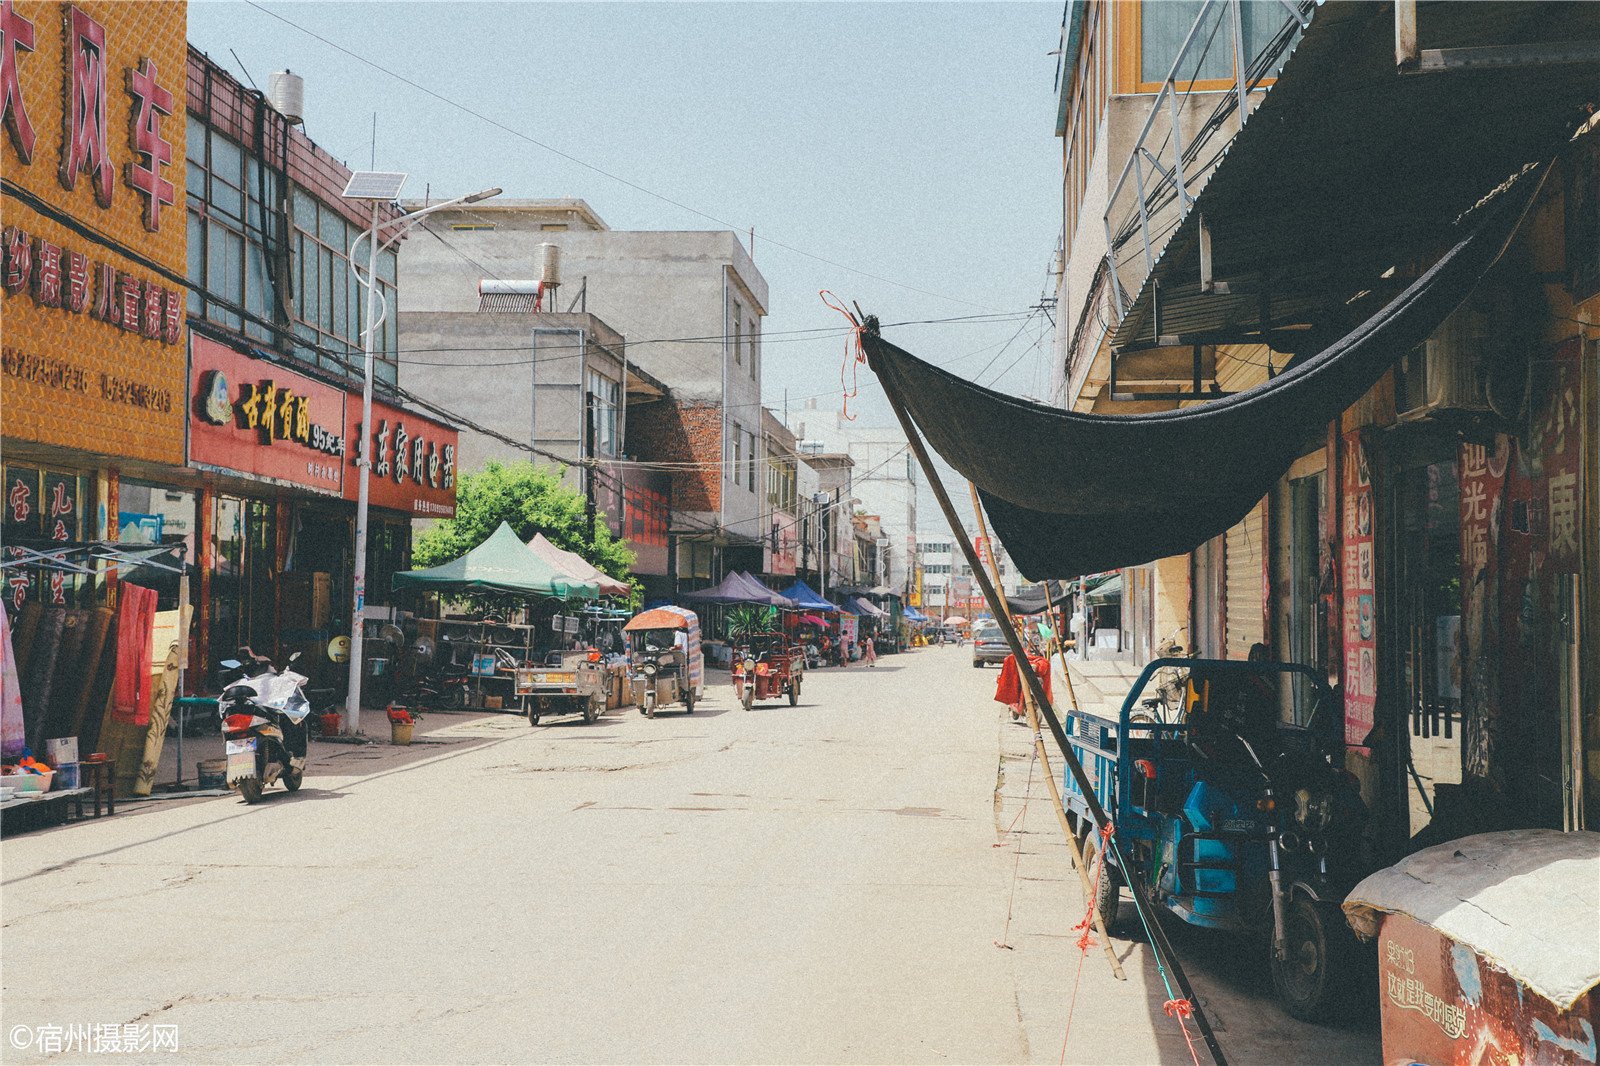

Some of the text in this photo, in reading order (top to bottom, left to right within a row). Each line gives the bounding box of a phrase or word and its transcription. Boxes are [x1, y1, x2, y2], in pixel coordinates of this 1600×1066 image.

[0, 225, 182, 346] 纱摄影儿童摄影
[242, 379, 311, 446] 古井贡酒
[354, 419, 455, 490] 东家用电器
[1387, 970, 1469, 1038] 这就是我要的感觉
